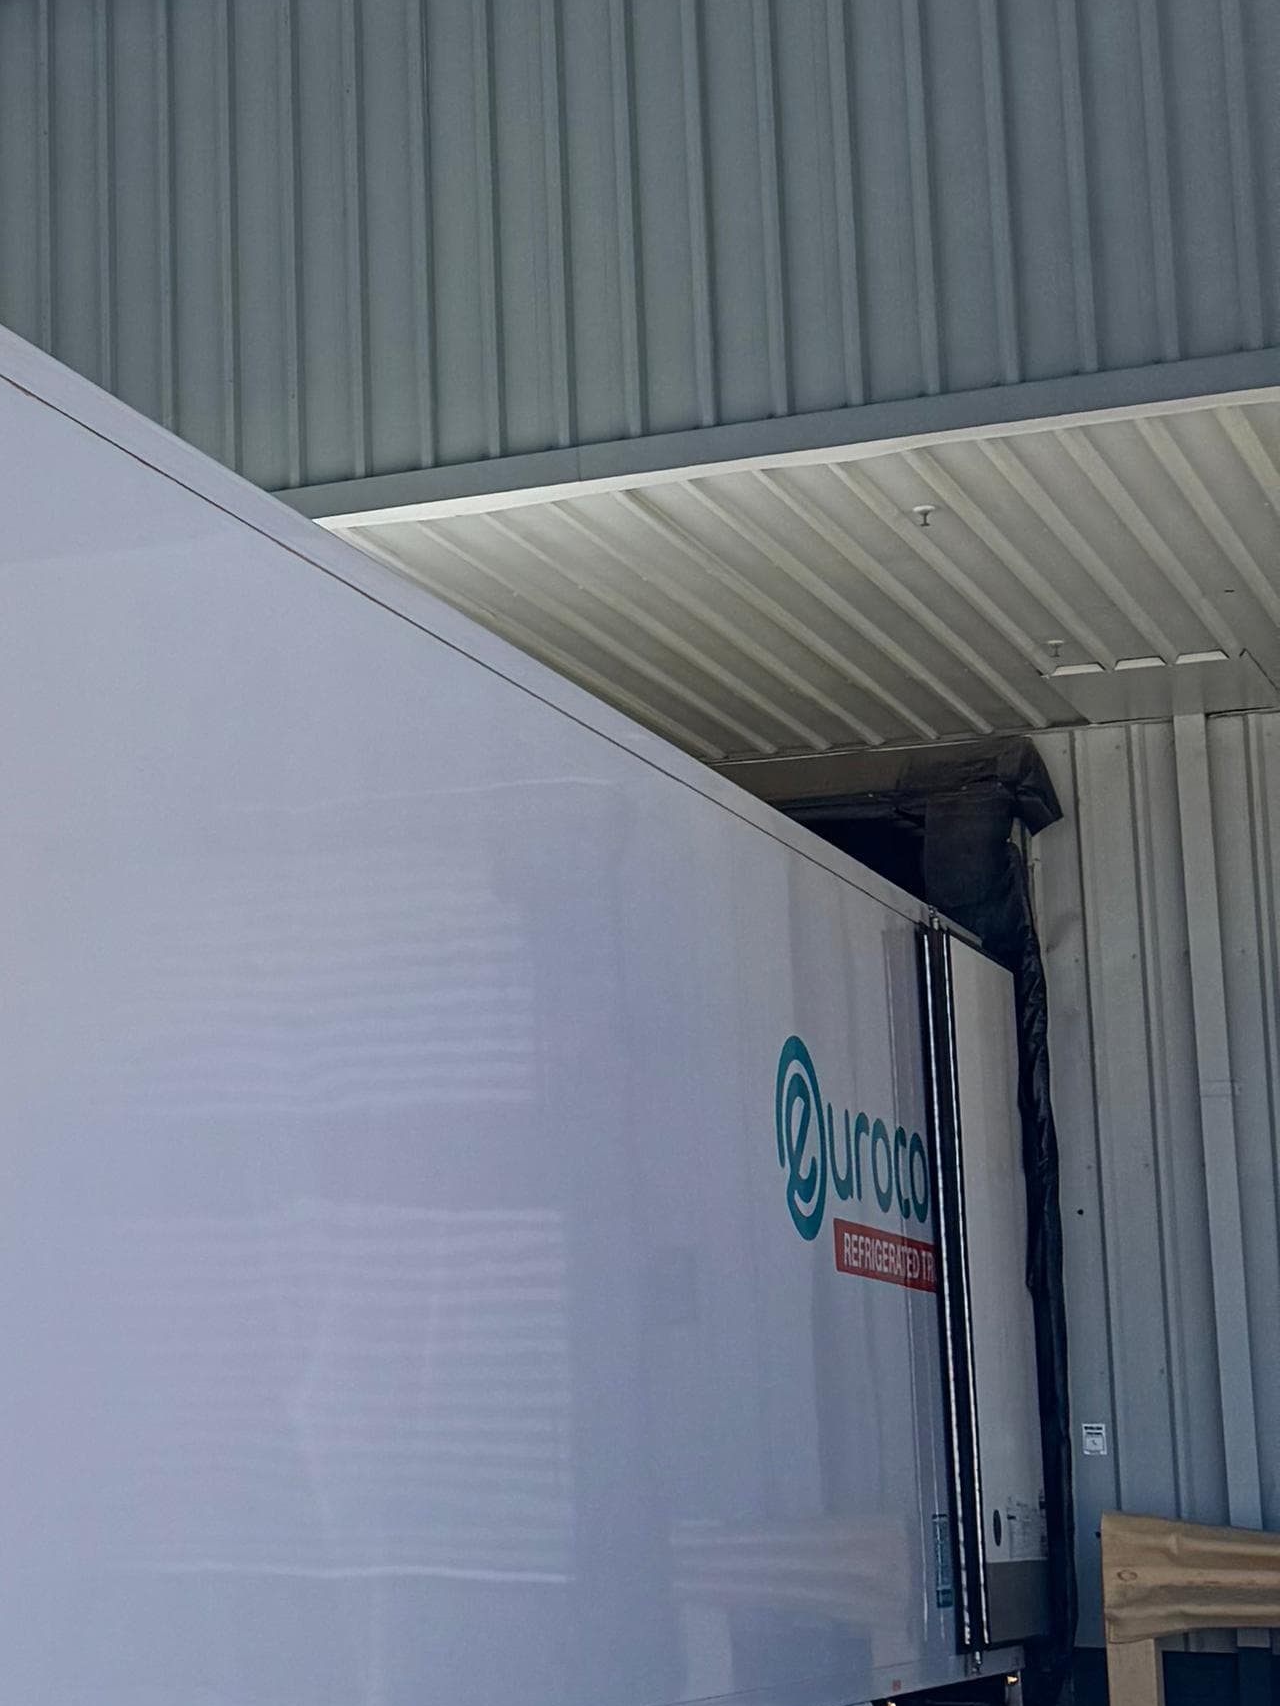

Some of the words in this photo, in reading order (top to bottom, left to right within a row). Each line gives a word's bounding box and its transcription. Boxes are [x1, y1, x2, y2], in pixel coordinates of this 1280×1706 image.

[775, 1035, 929, 1242] euroco
[843, 1232, 920, 1279] REFRIGERATED
[921, 1250, 936, 1283] TR
